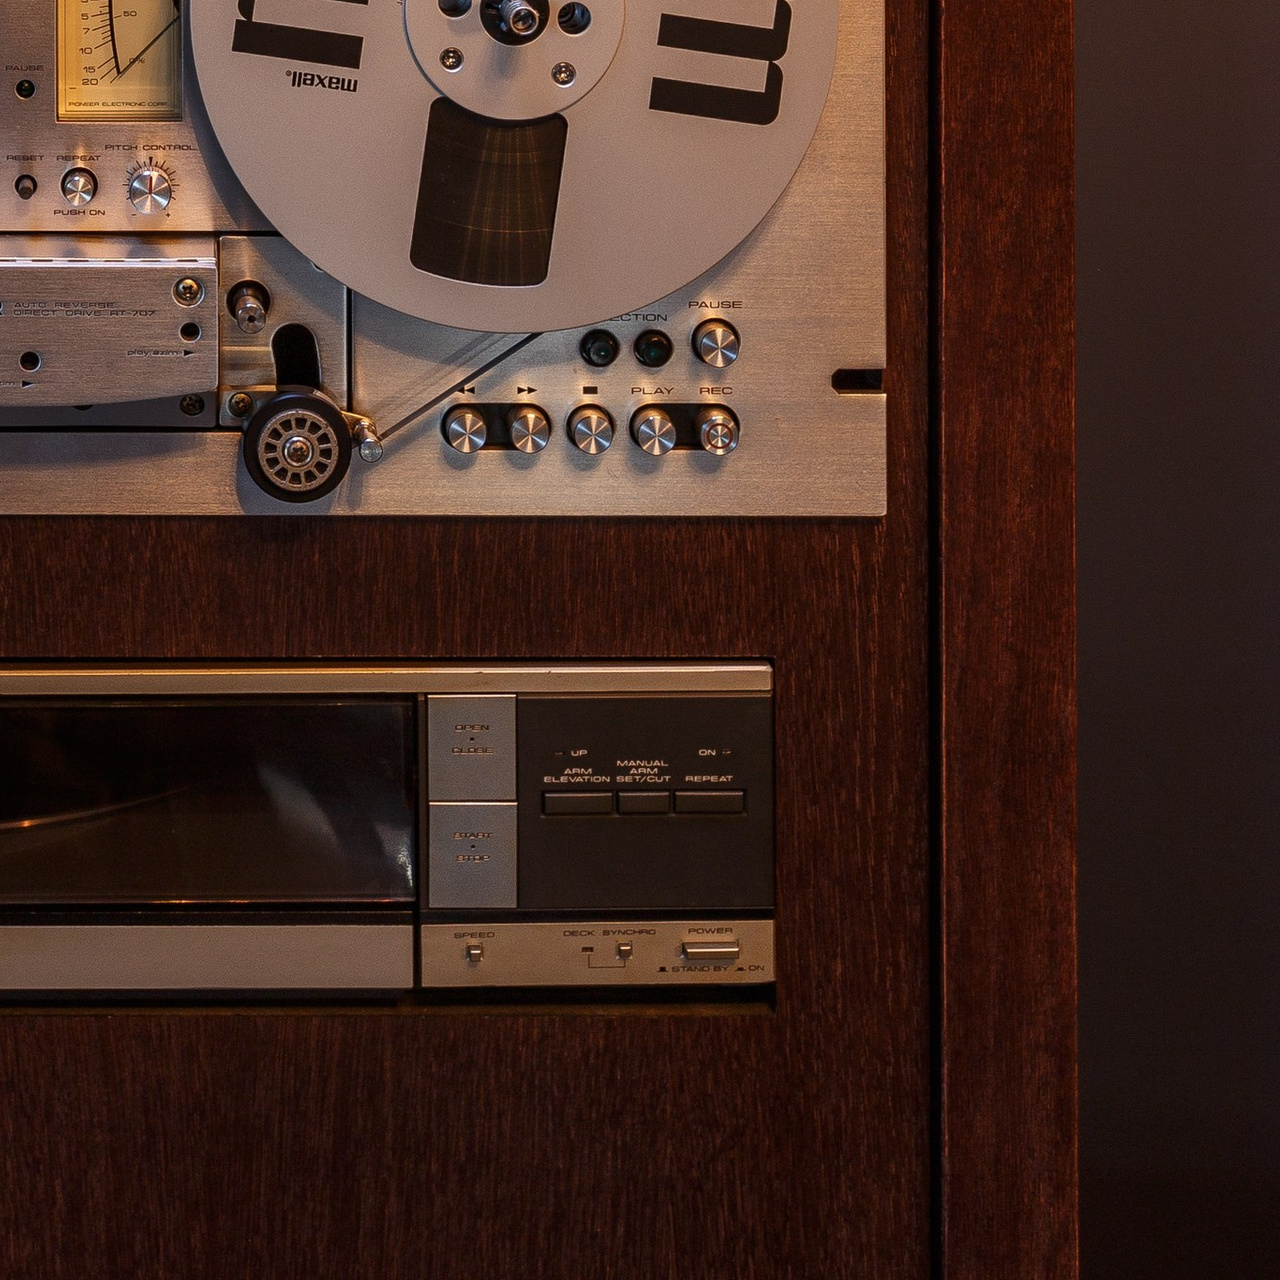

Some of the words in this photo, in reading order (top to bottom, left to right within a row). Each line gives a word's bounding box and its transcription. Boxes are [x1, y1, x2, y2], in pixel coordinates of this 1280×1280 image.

[292, 71, 358, 92] maxell
[689, 301, 742, 309] PAUSE
[127, 349, 151, 358] play
[631, 387, 674, 395] PLAY
[700, 387, 733, 395] REC
